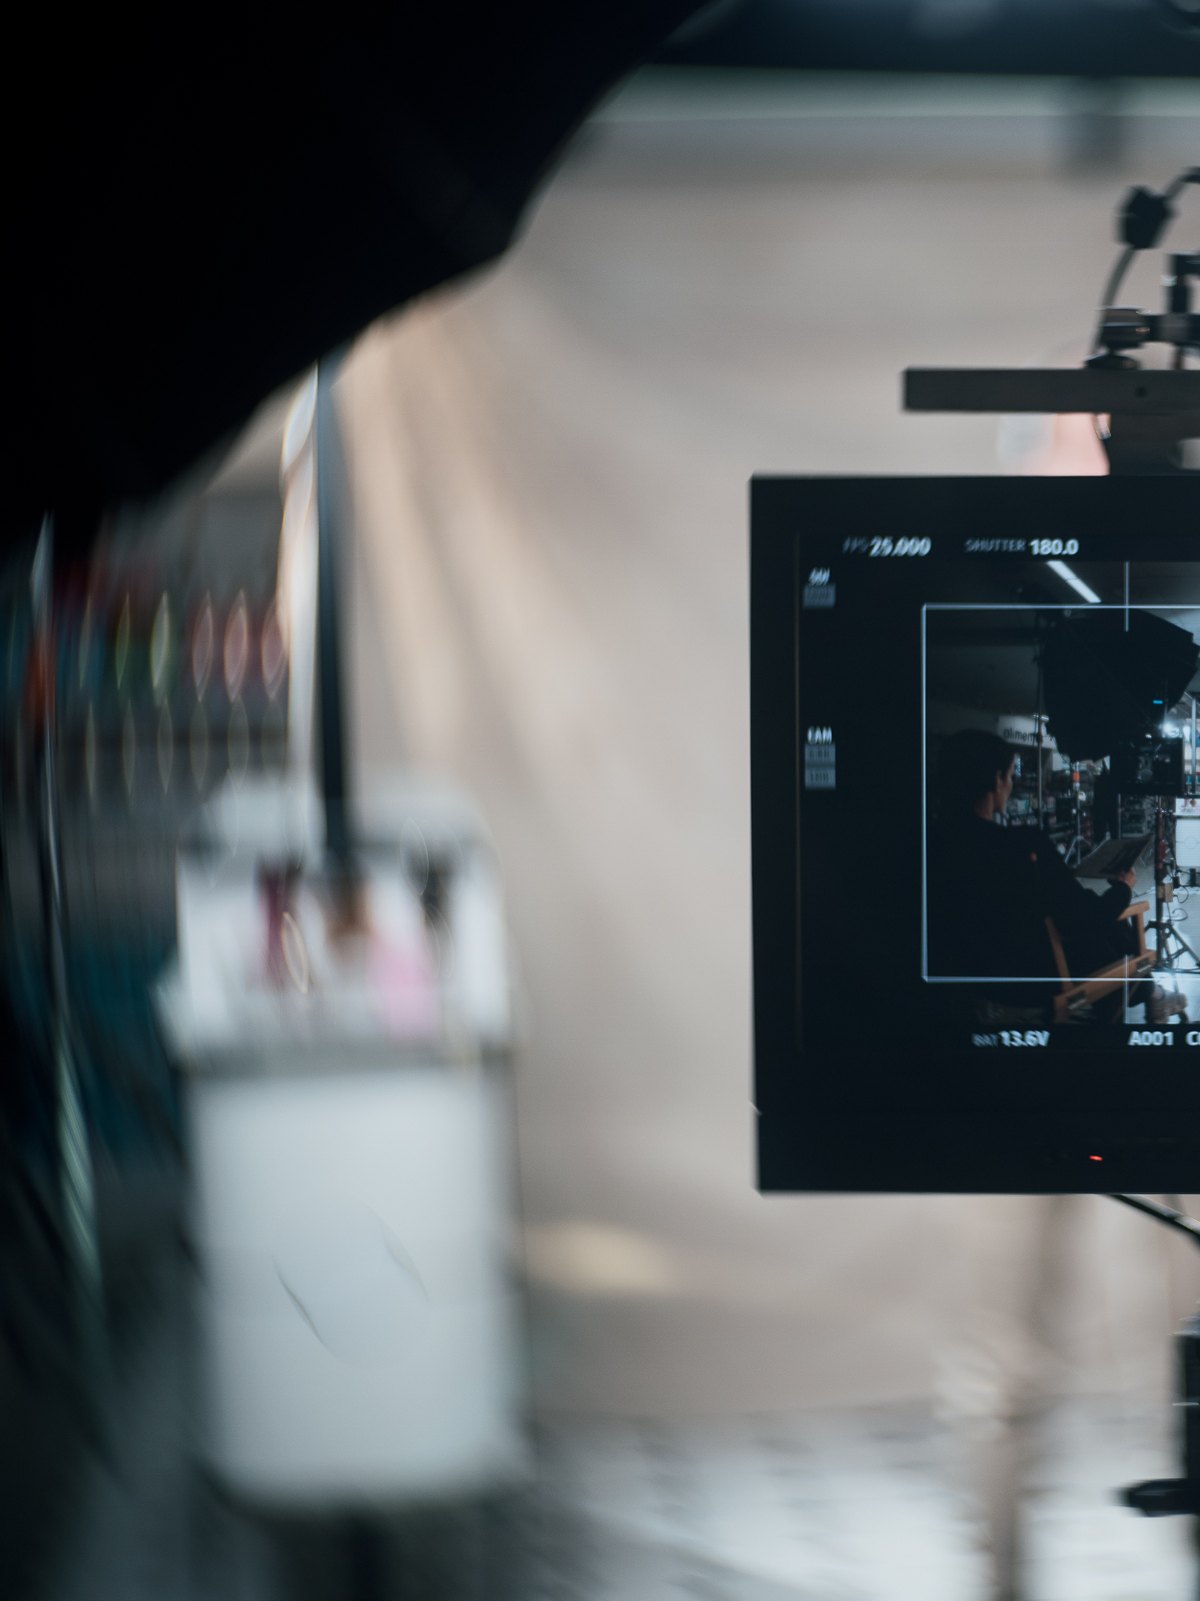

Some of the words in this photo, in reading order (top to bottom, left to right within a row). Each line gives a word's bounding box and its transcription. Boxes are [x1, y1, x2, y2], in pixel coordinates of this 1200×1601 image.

[965, 538, 1026, 553] SHUTTER
[1029, 538, 1078, 556] 180.0
[999, 1030, 1050, 1047] 13.6V
[1128, 1031, 1174, 1046] A001
